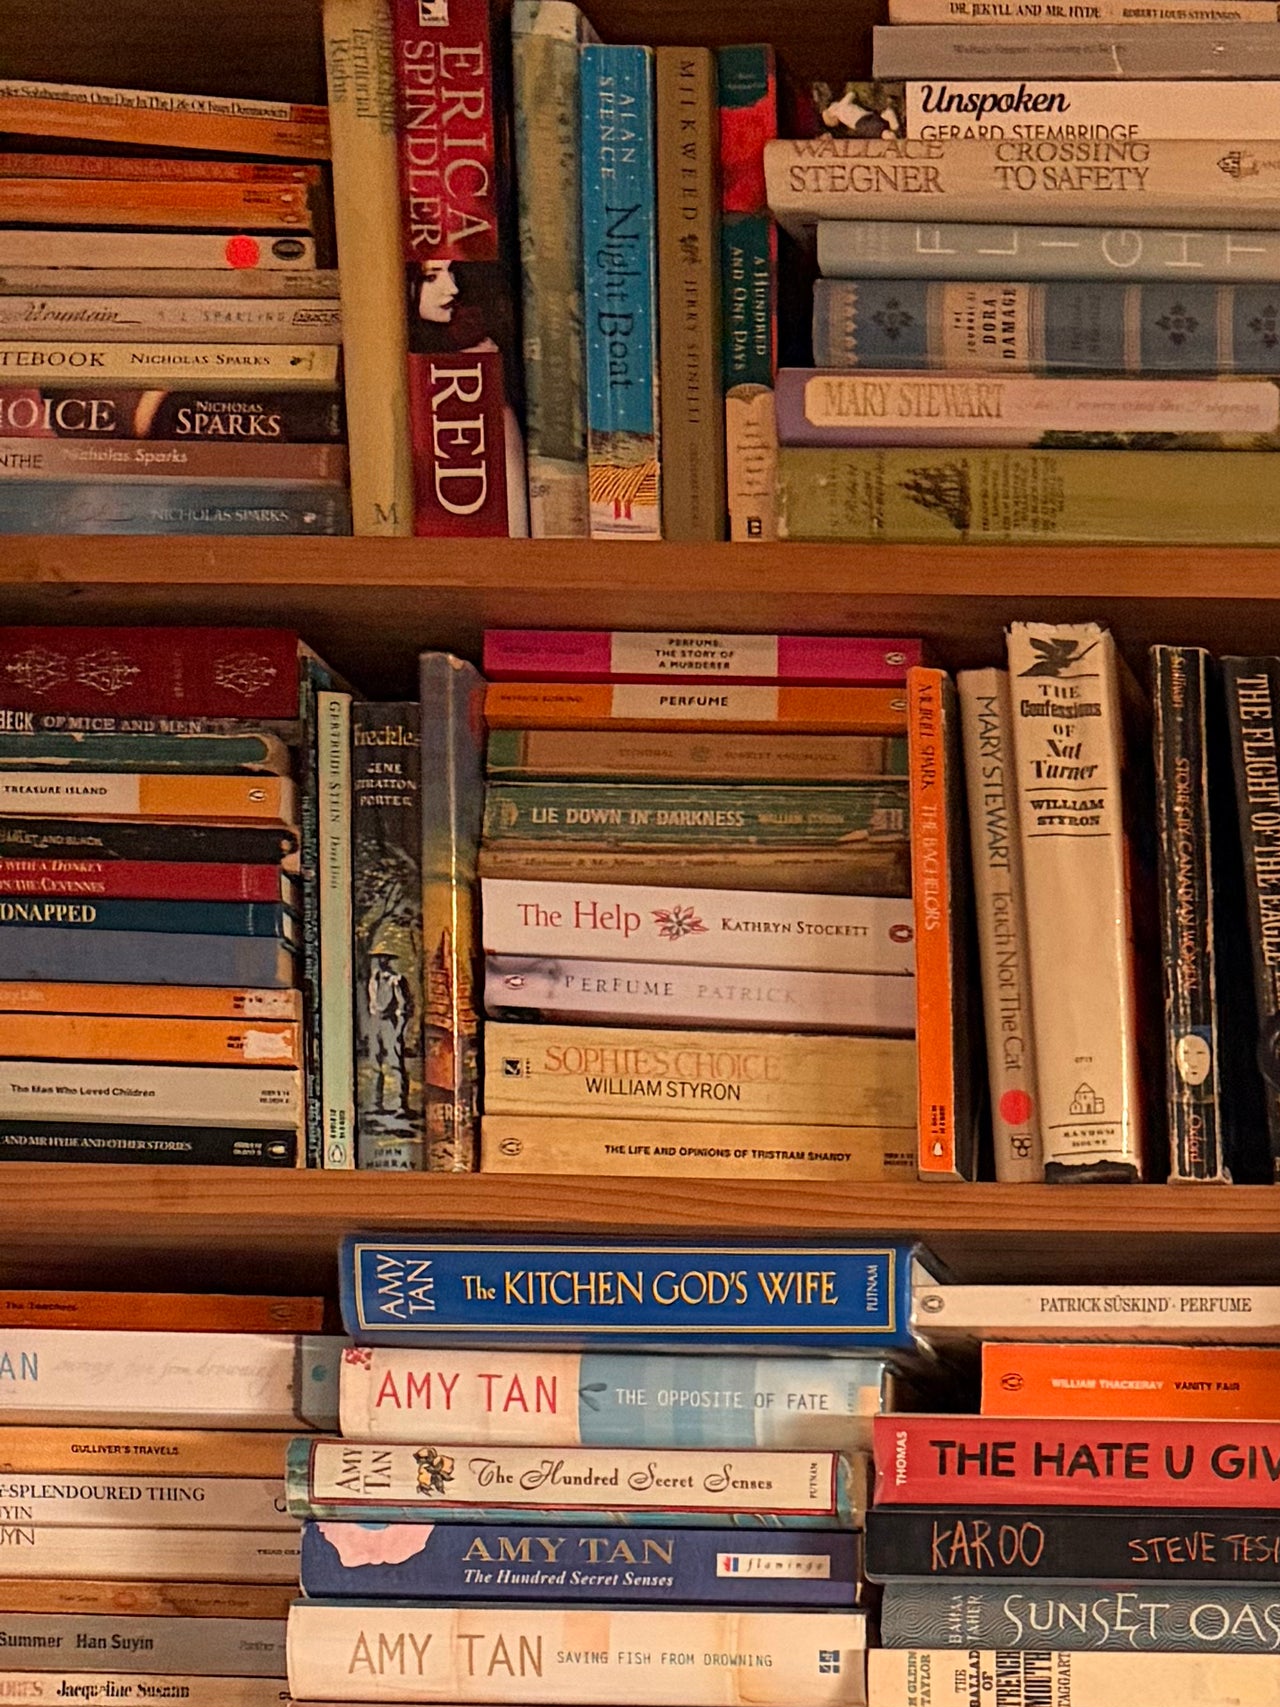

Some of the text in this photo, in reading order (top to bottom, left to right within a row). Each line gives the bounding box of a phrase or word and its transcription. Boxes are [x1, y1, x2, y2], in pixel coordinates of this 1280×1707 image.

[921, 85, 1070, 115] Unspoken
[402, 39, 442, 250] SPINDLER
[441, 42, 490, 246] ERICA
[789, 166, 945, 193] STEGNER
[430, 361, 488, 516] RED
[518, 903, 563, 929] The
[574, 901, 641, 936] Help
[462, 1269, 838, 1306] The KITCHEN GOD'S WIFE
[866, 1264, 880, 1312] PUTNAM
[375, 1375, 558, 1413] AMY TAN
[929, 1440, 1015, 1477] THE
[1032, 1443, 1149, 1478] HATE
[1164, 1446, 1194, 1479] U
[930, 1522, 1044, 1569] KAROO
[556, 1650, 772, 1668] SAVING FISH FROM DROWNING
